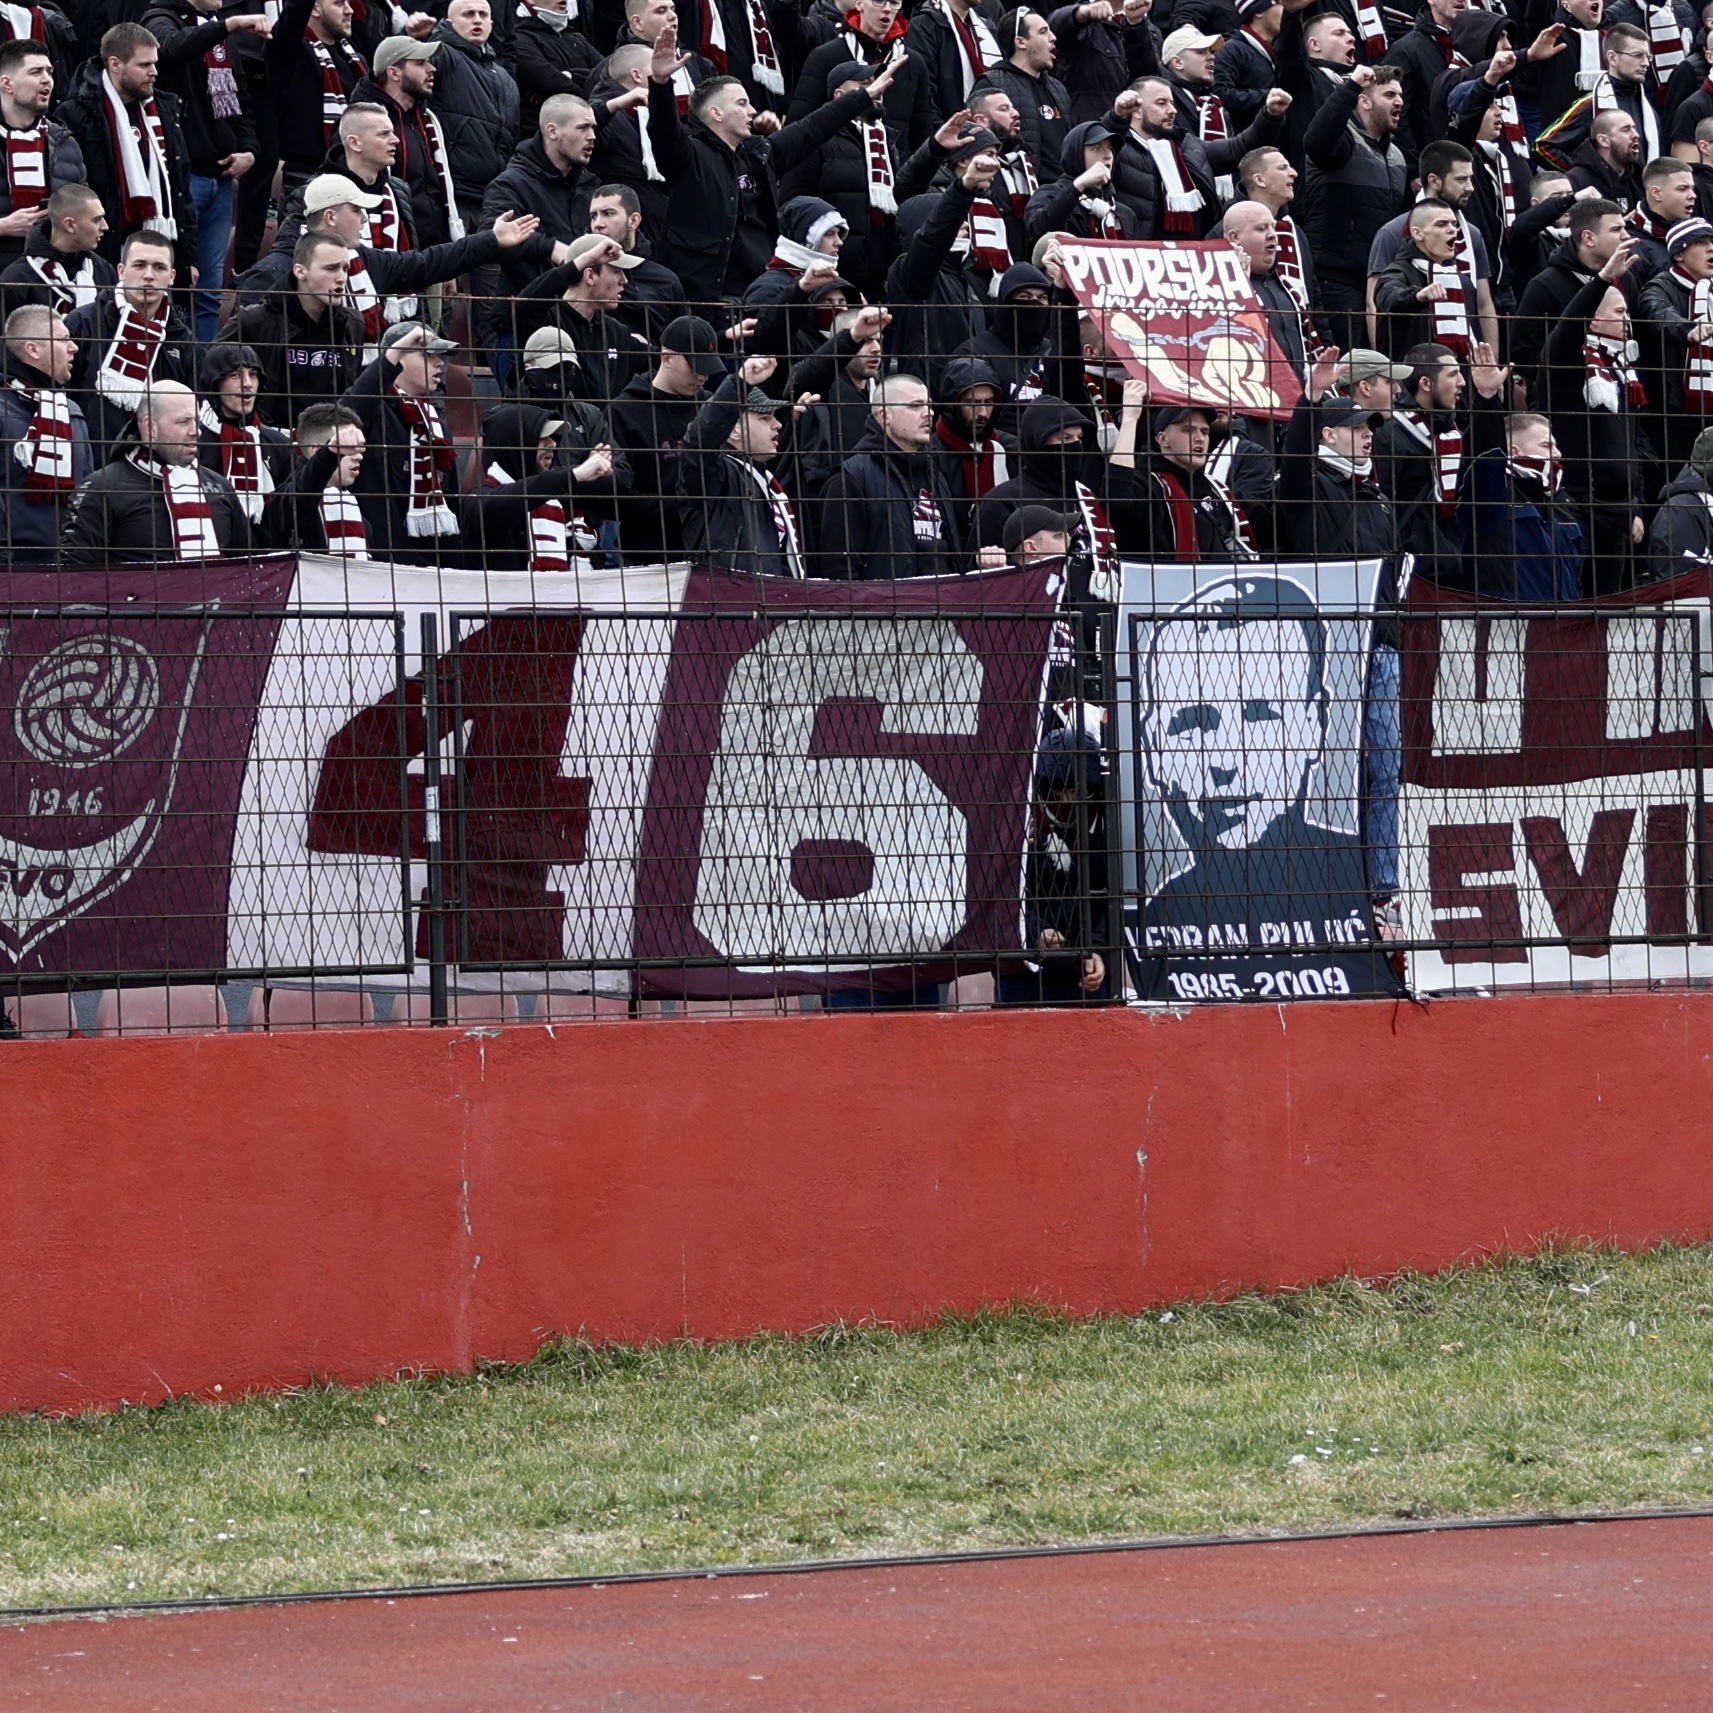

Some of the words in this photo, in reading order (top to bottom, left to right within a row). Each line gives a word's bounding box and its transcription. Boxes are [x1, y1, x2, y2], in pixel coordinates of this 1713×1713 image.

[1060, 241, 1255, 301] PODRŠKA
[1432, 616, 1529, 756] U
[29, 786, 105, 816] 1946
[1124, 922, 1249, 962] VEDRAN
[1168, 966, 1350, 1000] 1985-2009
